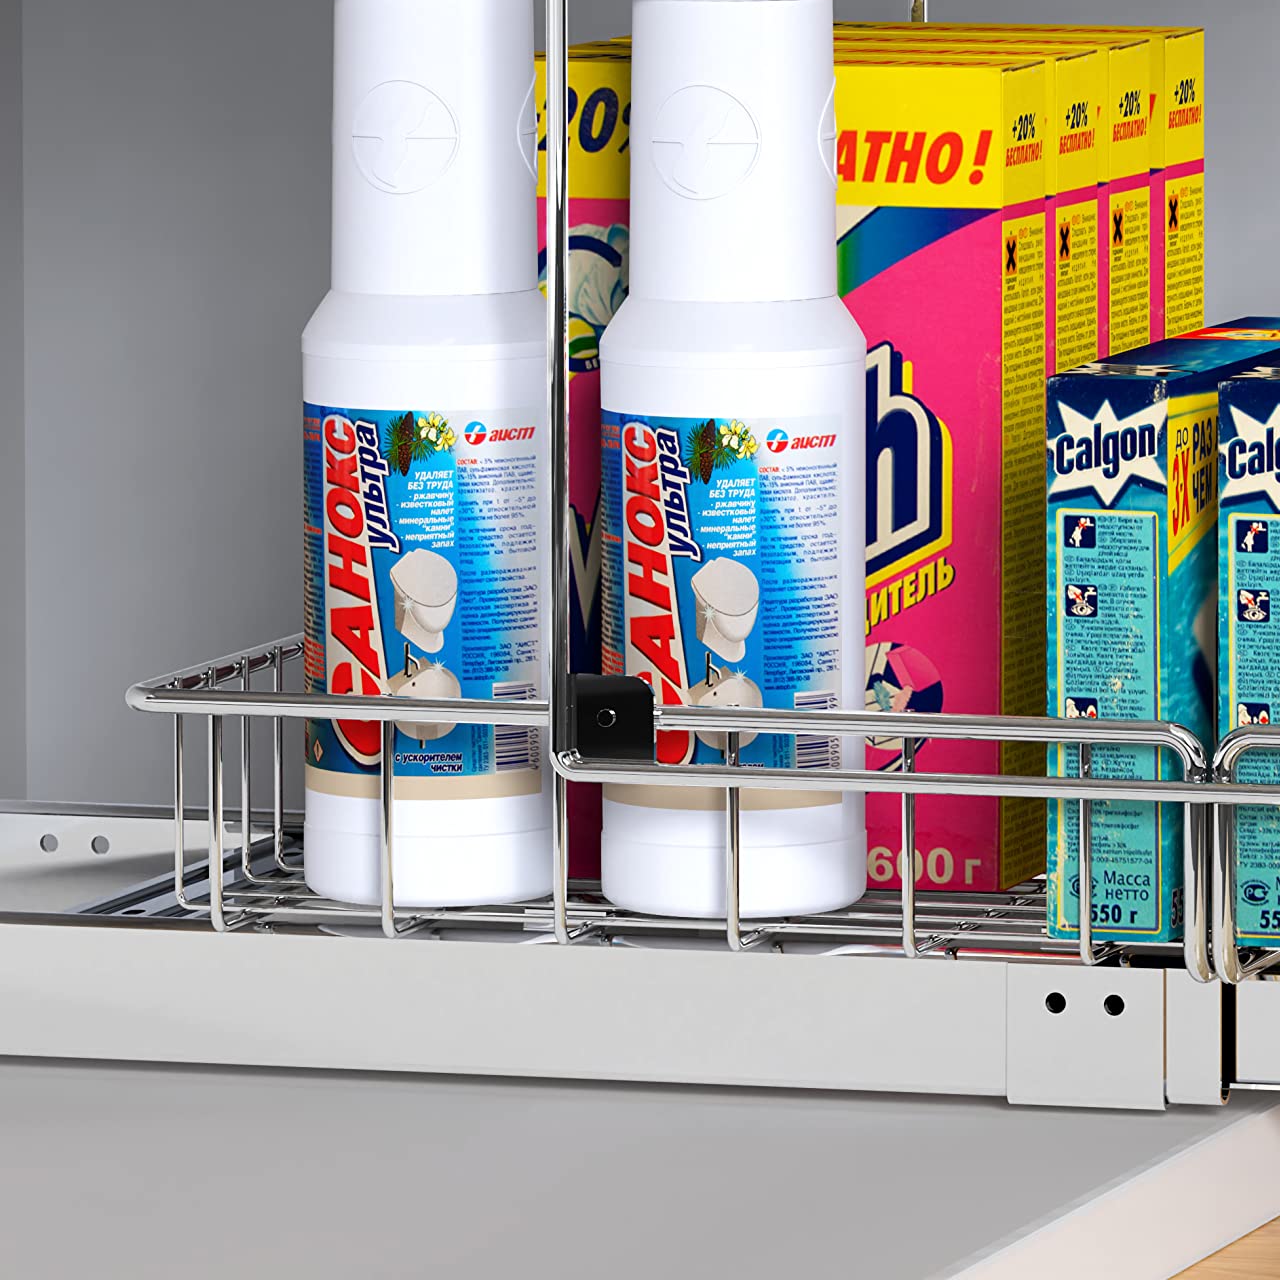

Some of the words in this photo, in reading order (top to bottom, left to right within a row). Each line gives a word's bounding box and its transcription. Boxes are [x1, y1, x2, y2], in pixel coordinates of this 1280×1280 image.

[1174, 78, 1195, 105] +20%
[1119, 90, 1141, 118] +20%
[1066, 101, 1089, 129] +20%
[1168, 104, 1202, 129] БЕСПЛАТНО!
[1012, 112, 1036, 141] +20%
[1112, 116, 1147, 142] БЕСПЛАТНО!
[1059, 128, 1095, 154] БЕСПЛАТНО!
[837, 130, 993, 185] АТНО!
[1006, 140, 1043, 168] БЕСПЛАТНО!
[1176, 428, 1189, 452] ДО
[1193, 418, 1213, 466] РАЗ
[1056, 423, 1156, 479] Calgon
[414, 470, 454, 481] УДАЛЯЕТ
[716, 478, 756, 489] УДАЛЯЕТ
[356, 420, 399, 553] ультра
[407, 481, 424, 490] БЕЗ
[426, 480, 454, 491] ТРУДА
[709, 489, 726, 498] БЕЗ
[727, 488, 755, 498] ТРУДА
[1193, 462, 1213, 515] ЧЕМ
[413, 492, 454, 501] ржавчину
[657, 429, 701, 562] ультра
[400, 500, 454, 508] известковый
[431, 508, 454, 516] налет
[715, 500, 755, 509] ржавчину
[399, 516, 454, 525] минеральные
[702, 508, 756, 517] известковый
[732, 516, 756, 524] налет
[405, 531, 454, 542] неприятный
[700, 524, 756, 534] минеральные
[706, 539, 756, 550] неприятный
[732, 549, 756, 557] запах
[325, 417, 382, 757] САНОКС
[402, 753, 462, 764] ускорителем
[431, 763, 462, 773] чистки
[867, 846, 954, 884] 600
[964, 858, 981, 885] г
[1103, 870, 1151, 886] Масса
[1105, 888, 1149, 901] нетто
[1091, 904, 1122, 924] 550
[1129, 910, 1138, 924] г
